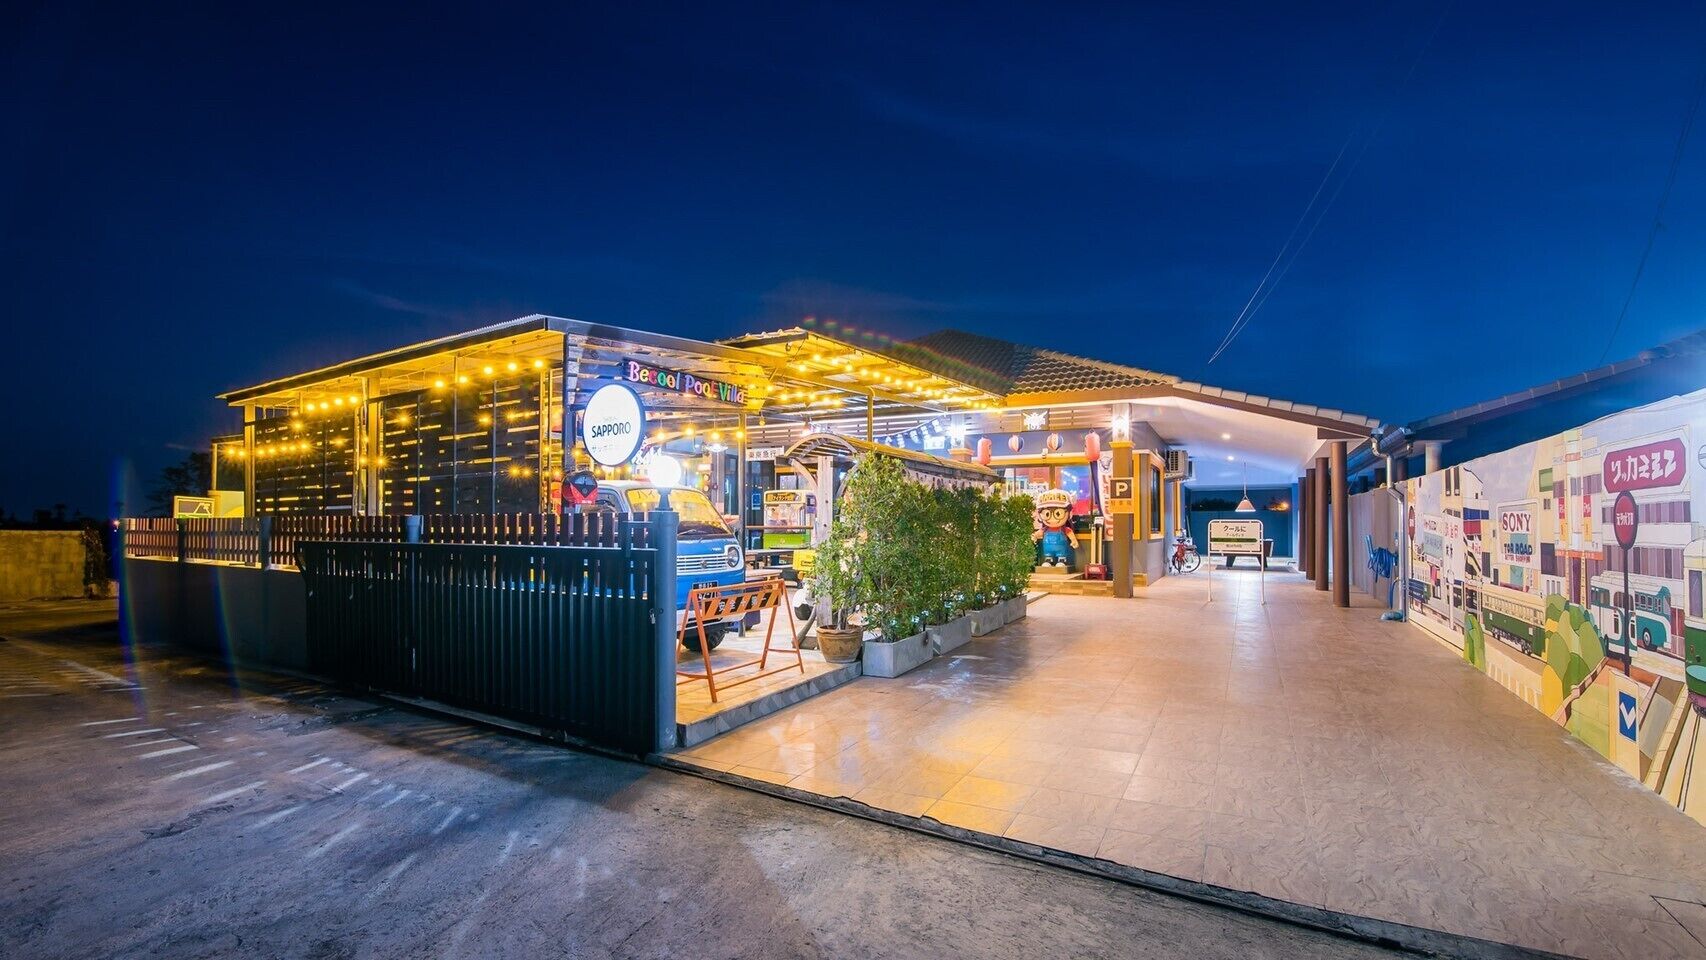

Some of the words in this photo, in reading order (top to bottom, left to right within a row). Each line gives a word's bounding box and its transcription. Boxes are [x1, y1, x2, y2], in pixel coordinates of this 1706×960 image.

[628, 361, 680, 390] Becool
[719, 383, 744, 403] Villa
[592, 421, 631, 438] SAPPORO
[1116, 482, 1128, 497] P
[1502, 512, 1531, 532] SONY
[1515, 543, 1533, 555] ROAD
